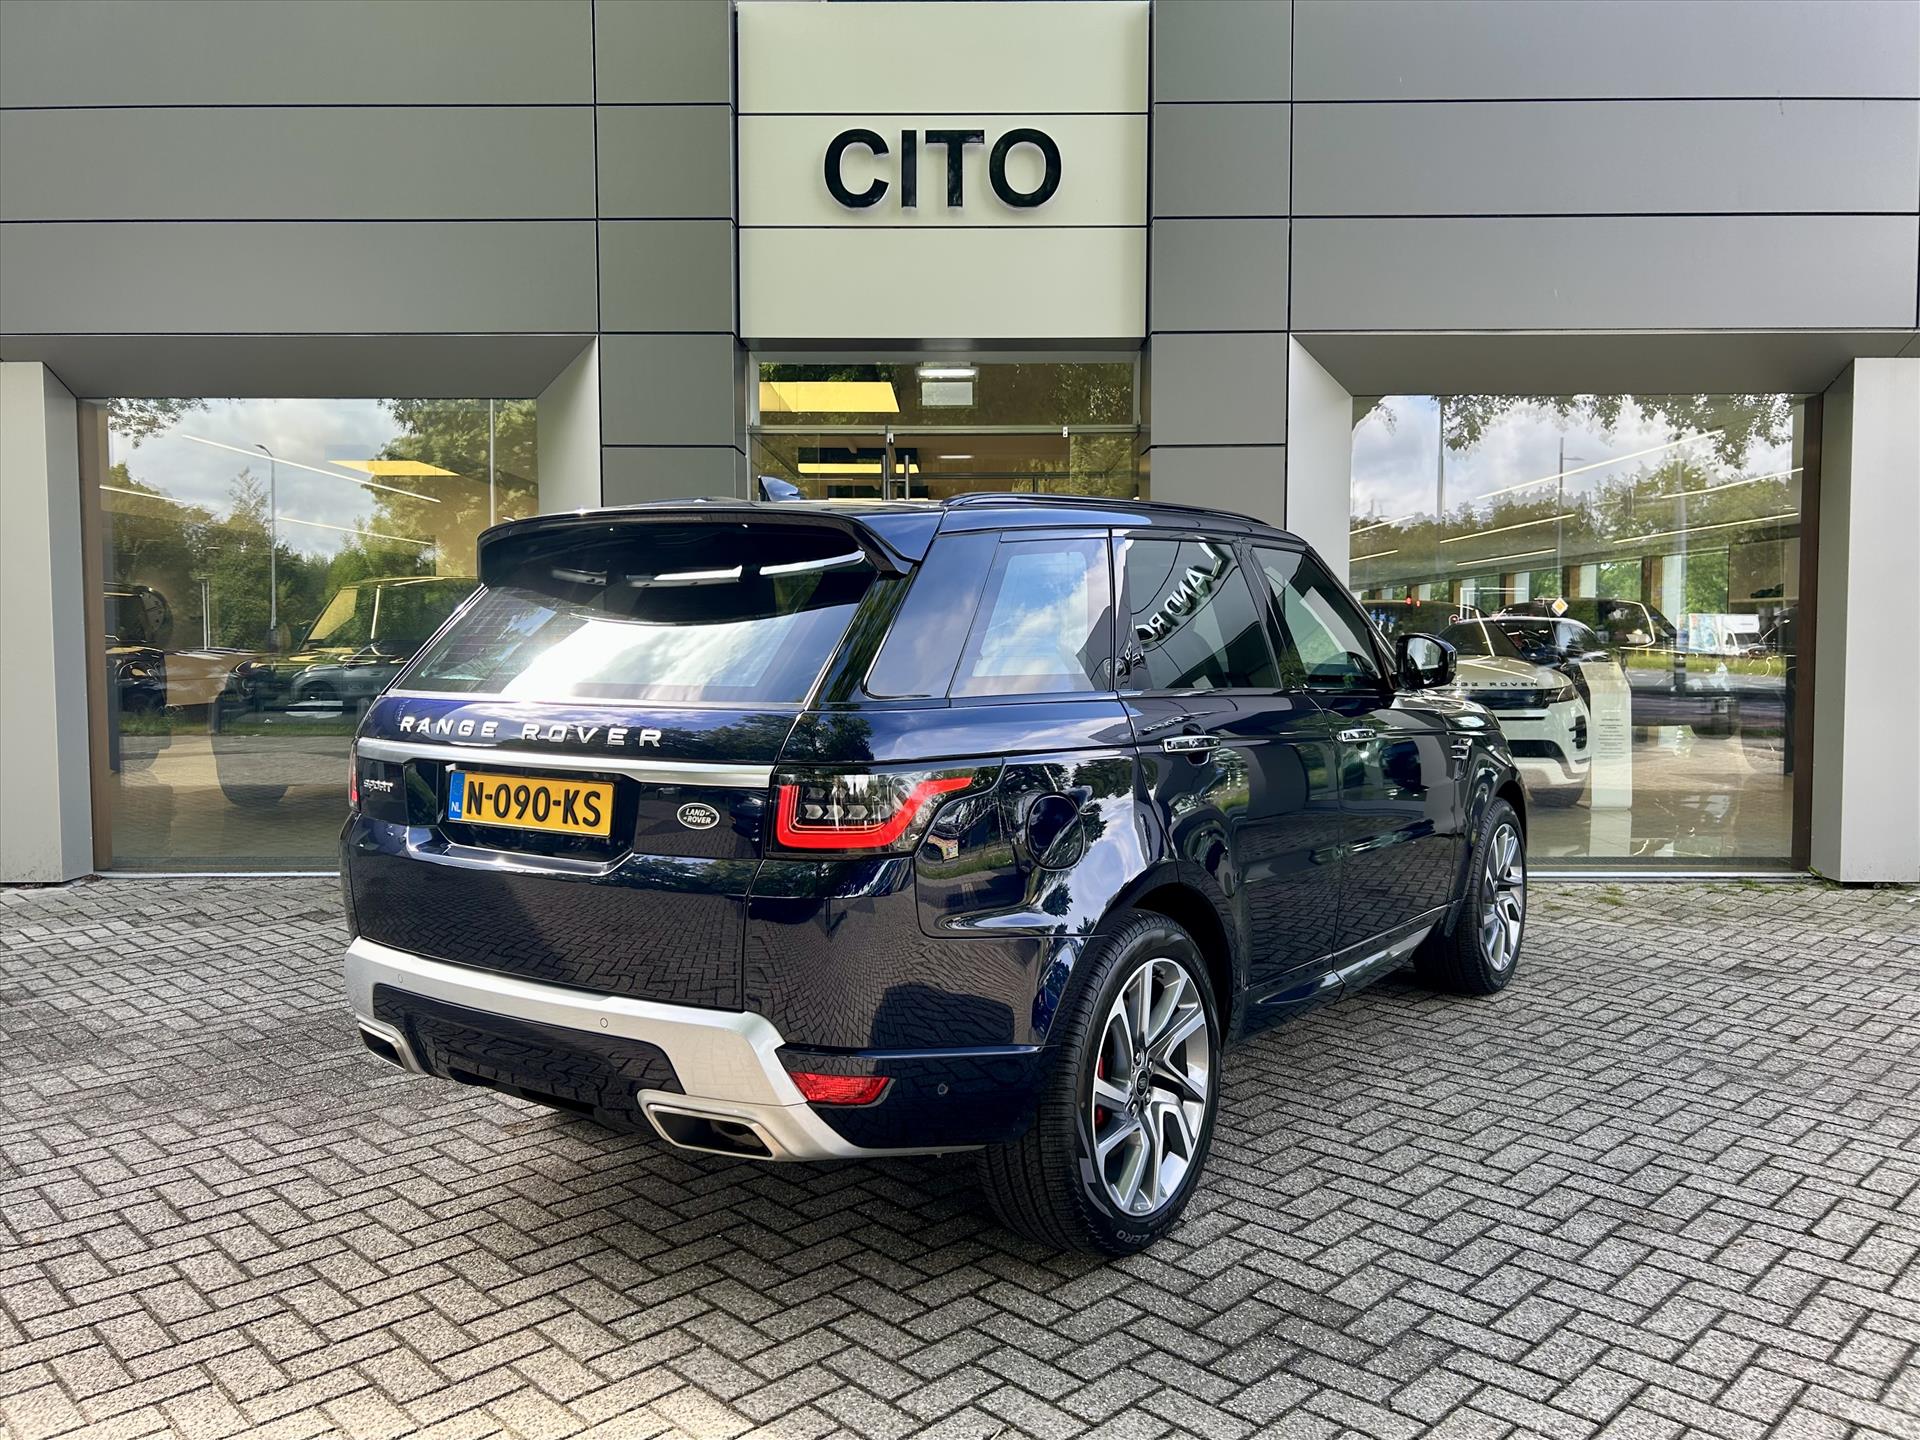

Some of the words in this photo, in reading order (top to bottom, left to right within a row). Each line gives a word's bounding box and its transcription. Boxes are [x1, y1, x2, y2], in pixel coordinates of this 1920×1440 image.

[824, 128, 1062, 208] CITO
[399, 715, 499, 738] RANGE
[521, 723, 662, 747] ROVER
[363, 779, 394, 793] SPORT
[451, 801, 461, 813] NL
[466, 781, 601, 827] N-090-KS
[685, 808, 706, 817] LAND
[686, 816, 712, 824] ROVER
[1116, 1229, 1150, 1244] ZERO
